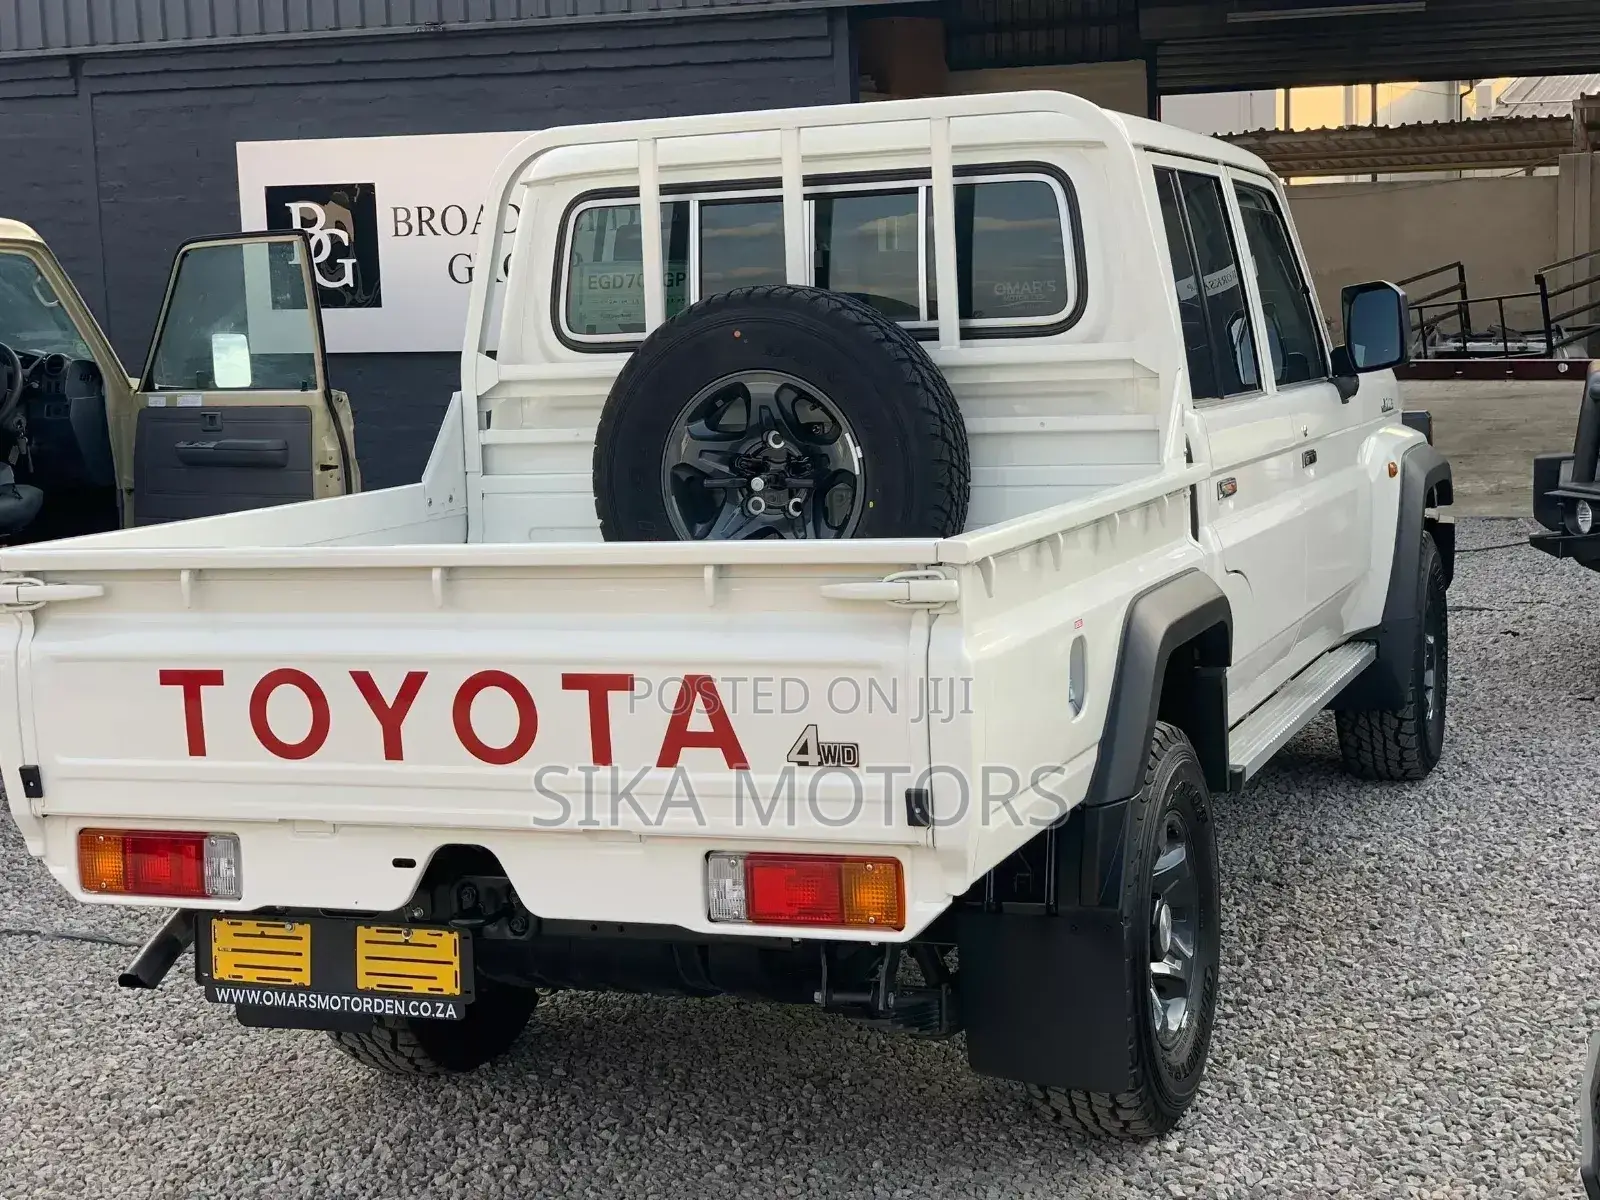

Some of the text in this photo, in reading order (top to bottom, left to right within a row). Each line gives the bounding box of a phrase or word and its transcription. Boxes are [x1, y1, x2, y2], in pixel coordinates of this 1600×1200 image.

[159, 668, 750, 770] TOYOTA
[787, 724, 859, 768] 4WD
[215, 987, 457, 1018] WWW.OMARSMOTORDEN.CO.ZA
